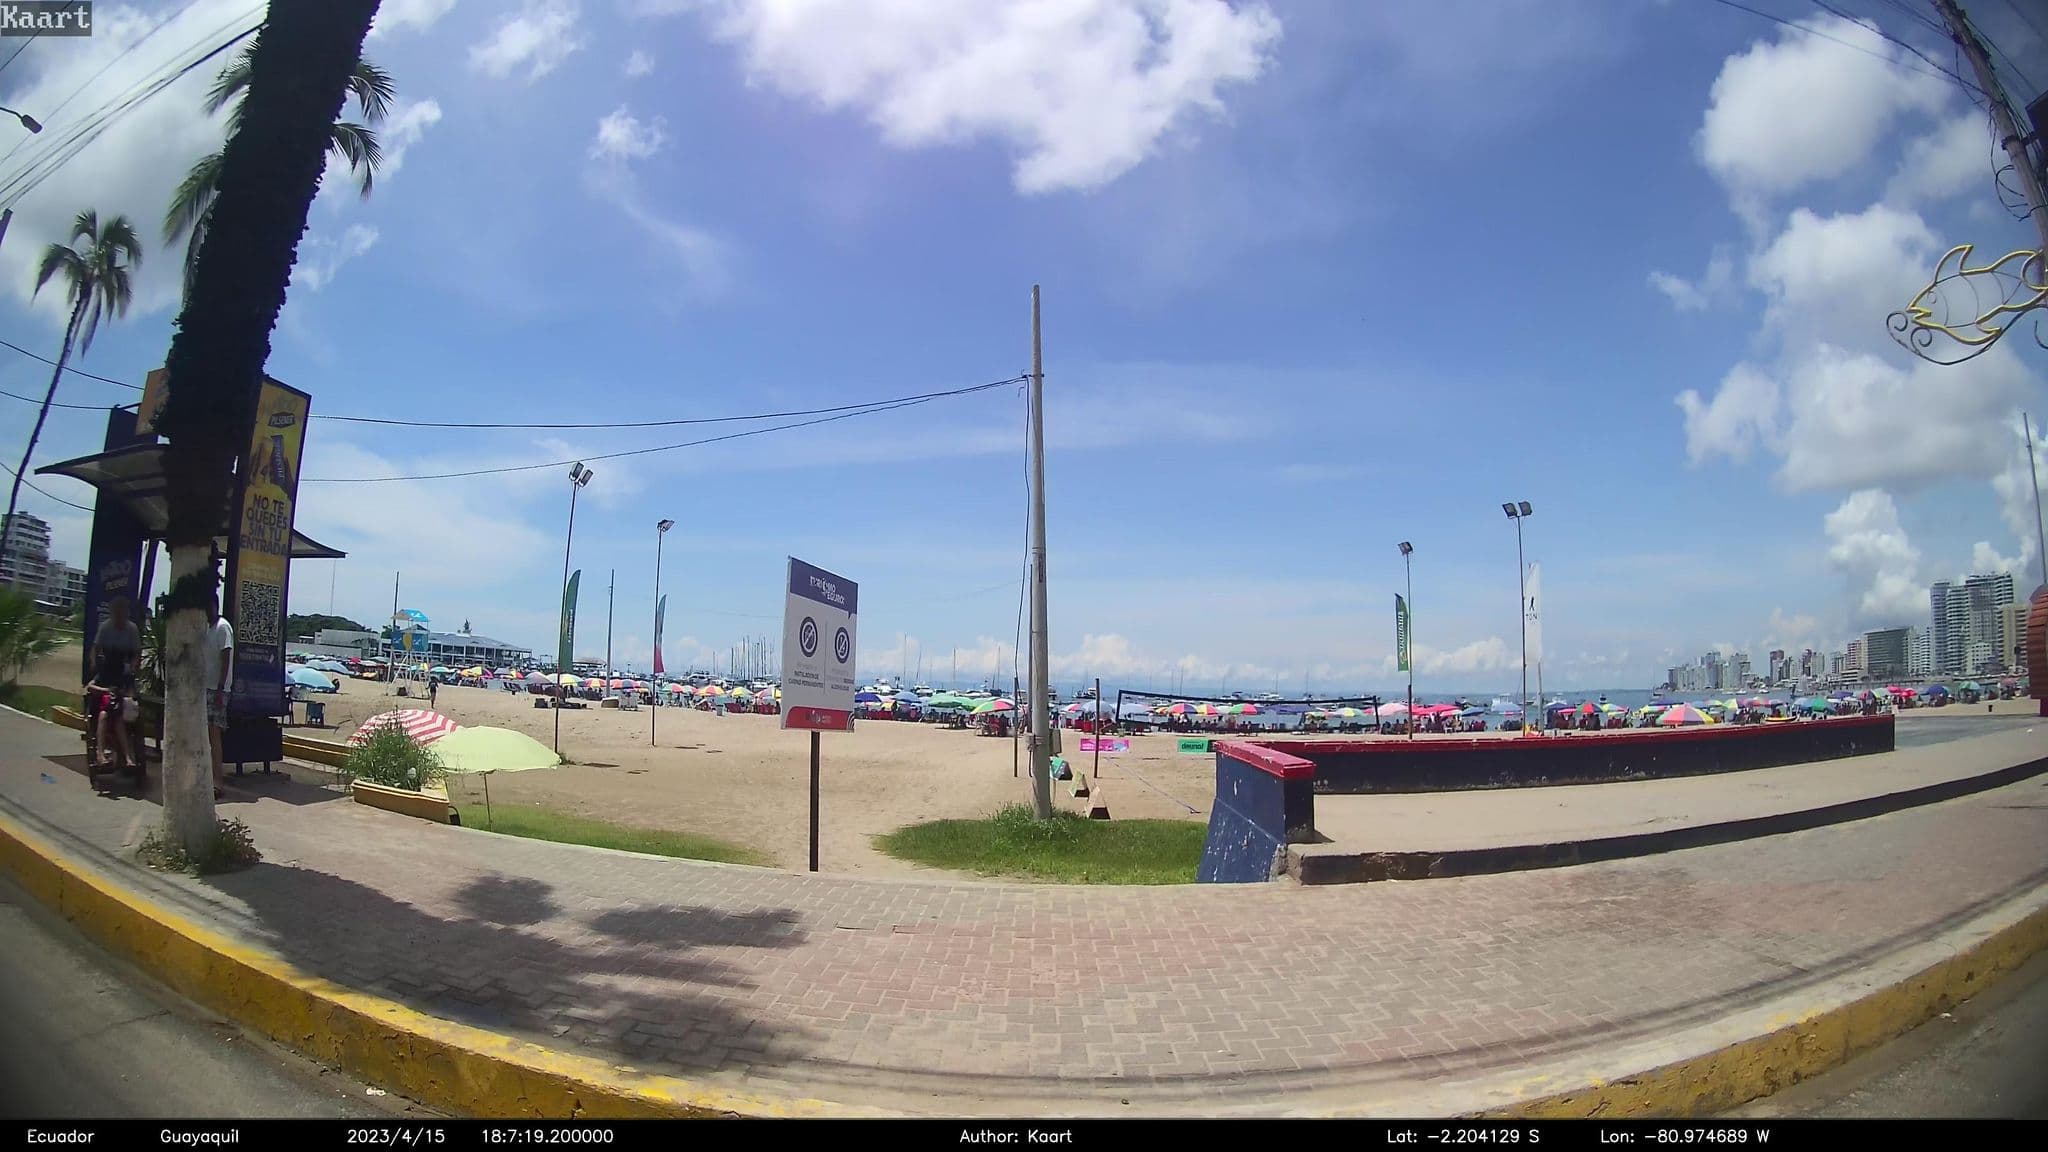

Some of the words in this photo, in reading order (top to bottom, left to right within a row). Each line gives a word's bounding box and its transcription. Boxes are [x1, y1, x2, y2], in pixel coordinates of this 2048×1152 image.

[253, 493, 269, 510] NO
[273, 499, 285, 515] TE
[246, 507, 288, 529] QUEDES
[248, 523, 265, 539] SIN
[270, 526, 282, 541] TU
[240, 535, 287, 555] ENTRADA
